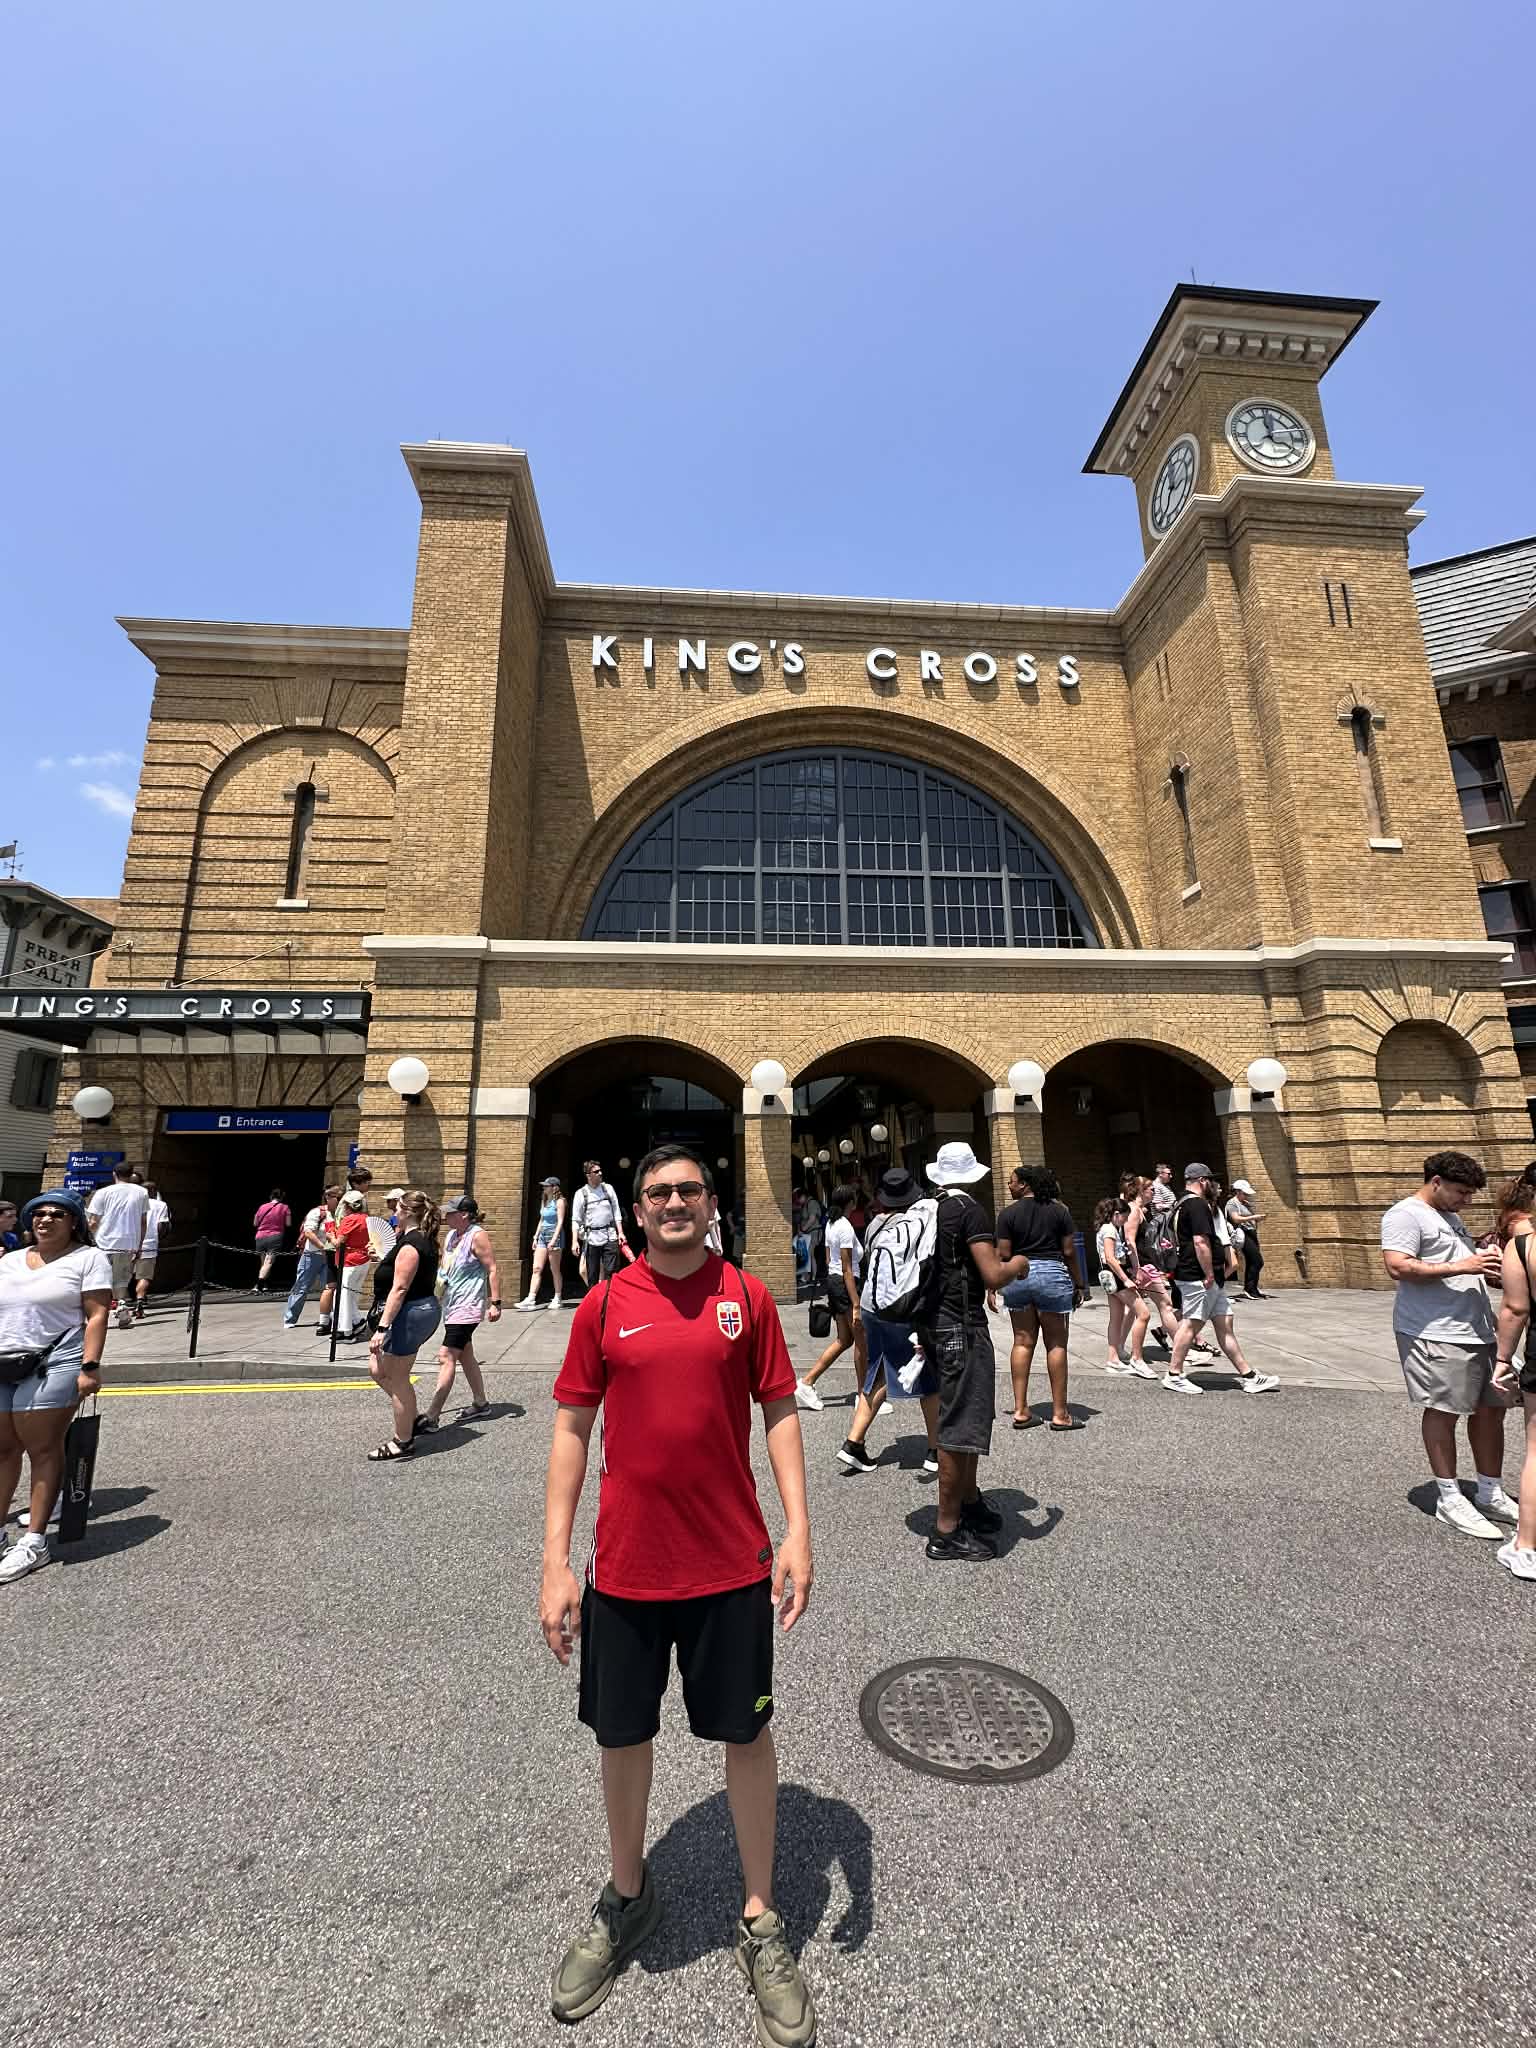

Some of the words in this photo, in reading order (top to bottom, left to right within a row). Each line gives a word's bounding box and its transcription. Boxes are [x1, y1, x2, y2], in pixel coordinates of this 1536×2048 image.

[591, 635, 804, 676] KING'S
[866, 647, 1080, 689] CROSS
[25, 940, 81, 972] FRESH
[23, 958, 77, 988] SALT
[180, 998, 333, 1016] CROSS
[236, 1116, 284, 1127] Entrance
